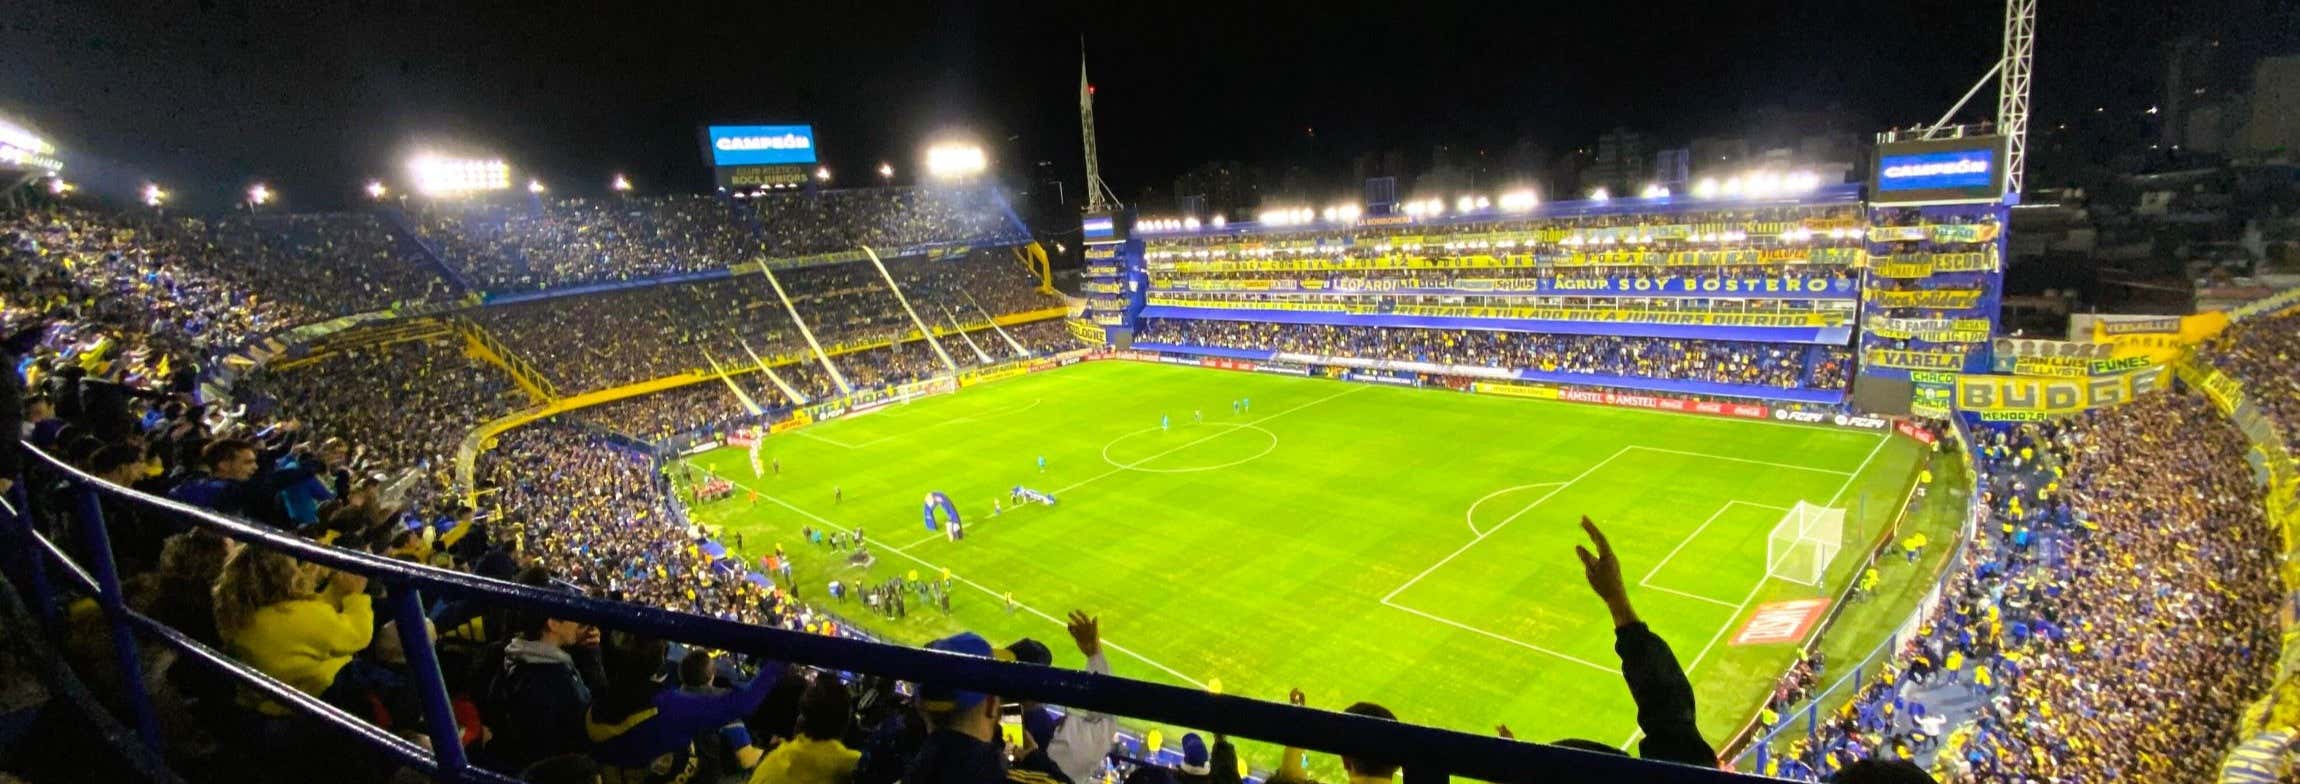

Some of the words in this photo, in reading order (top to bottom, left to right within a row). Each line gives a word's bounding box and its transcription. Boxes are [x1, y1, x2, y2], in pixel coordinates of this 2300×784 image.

[716, 134, 810, 151] CAMPEÓN
[1619, 278, 1669, 291] SOY
[1684, 278, 1829, 293] BOSTERO
[1517, 309, 1560, 320] LADO
[1568, 310, 1617, 322] BOCA
[1624, 312, 1705, 324] JUNIORS
[1711, 314, 1809, 326] QUERIDO
[1885, 352, 1961, 369] VARELA
[2018, 356, 2049, 367] SAN
[2051, 357, 2087, 368] LUIS
[2094, 355, 2151, 373] FUNES
[1912, 371, 1953, 383] CHACO
[1963, 367, 2164, 410] BUDGE
[1567, 392, 1602, 403] AMSTEL
[1617, 396, 1656, 407] AMSTEL
[1982, 411, 2047, 421] MENDOZA
